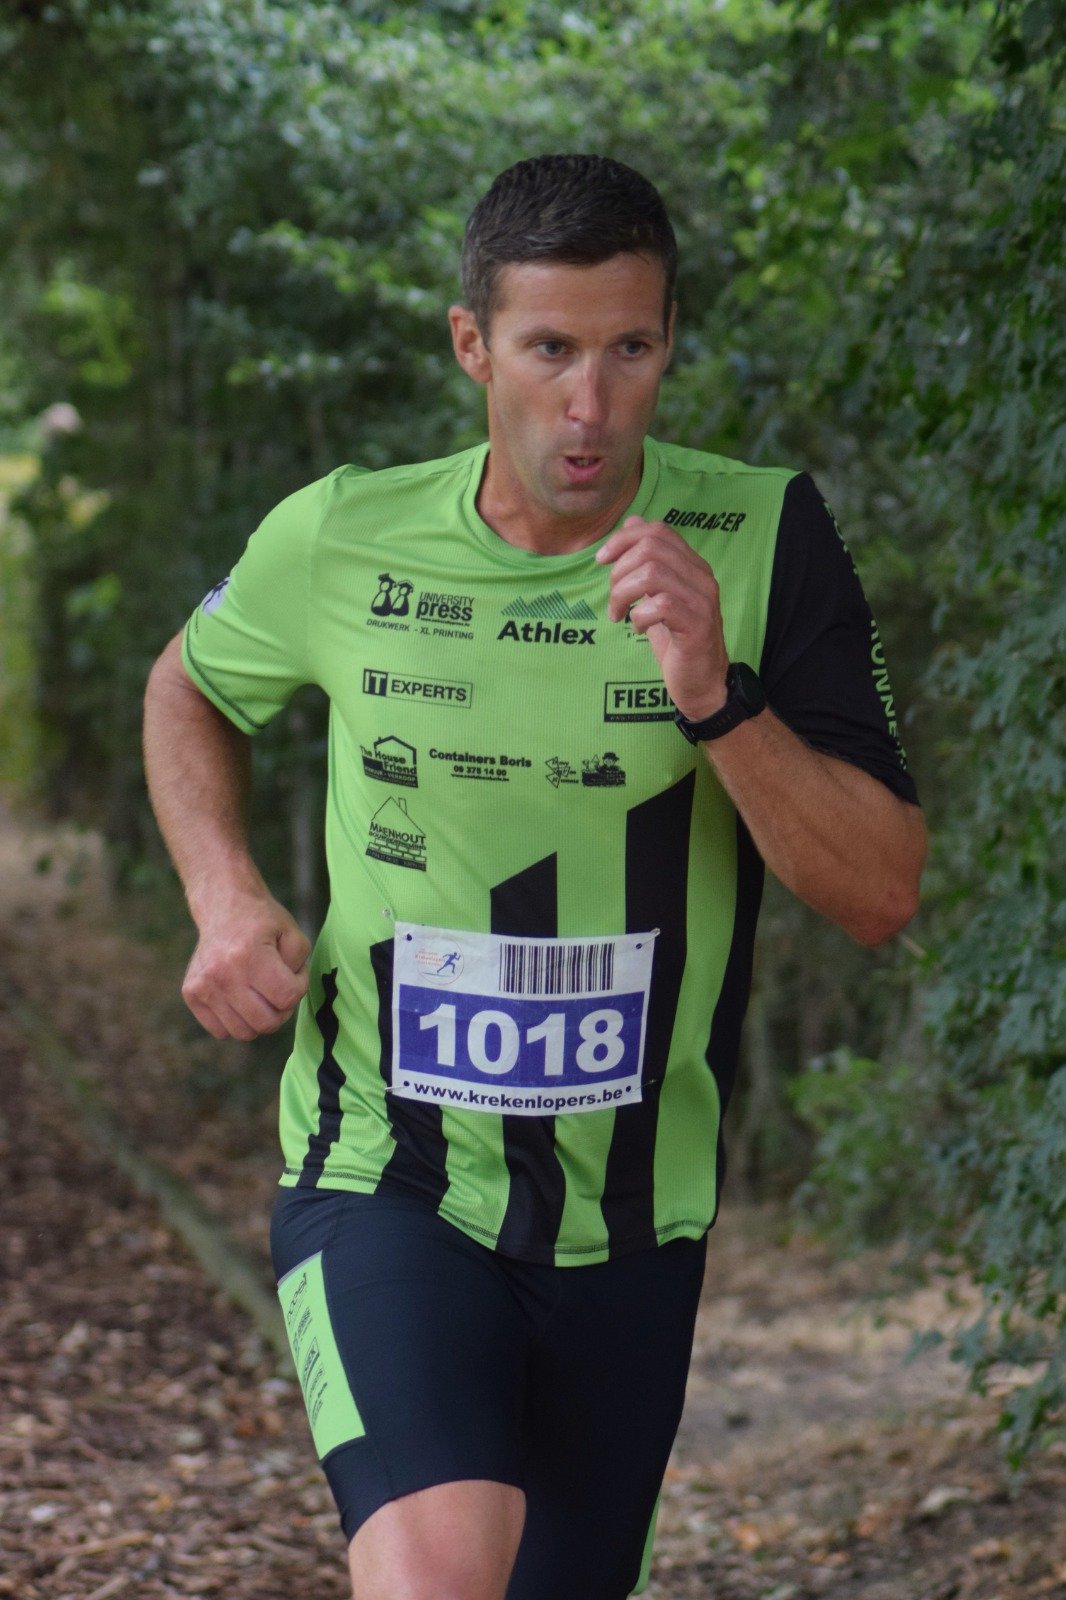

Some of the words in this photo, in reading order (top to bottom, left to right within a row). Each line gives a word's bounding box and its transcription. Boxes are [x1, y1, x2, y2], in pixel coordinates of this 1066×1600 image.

[663, 507, 746, 532] BIORACER
[419, 591, 475, 607] UNIVERSITY
[415, 601, 473, 621] press
[366, 619, 410, 632] DRUKWERK
[419, 627, 430, 635] XL
[433, 628, 474, 640] PRINTING
[497, 620, 597, 645] Athlex
[364, 671, 387, 694] IT
[391, 679, 467, 702] EXPERTS
[375, 750, 406, 764] House
[384, 761, 417, 775] Friend
[429, 748, 496, 765] Containers
[499, 755, 532, 768] Boris
[370, 821, 426, 845] MAENHOUT
[419, 1003, 625, 1076] 1018
[414, 1081, 623, 1111] www.krekenlopers.be
